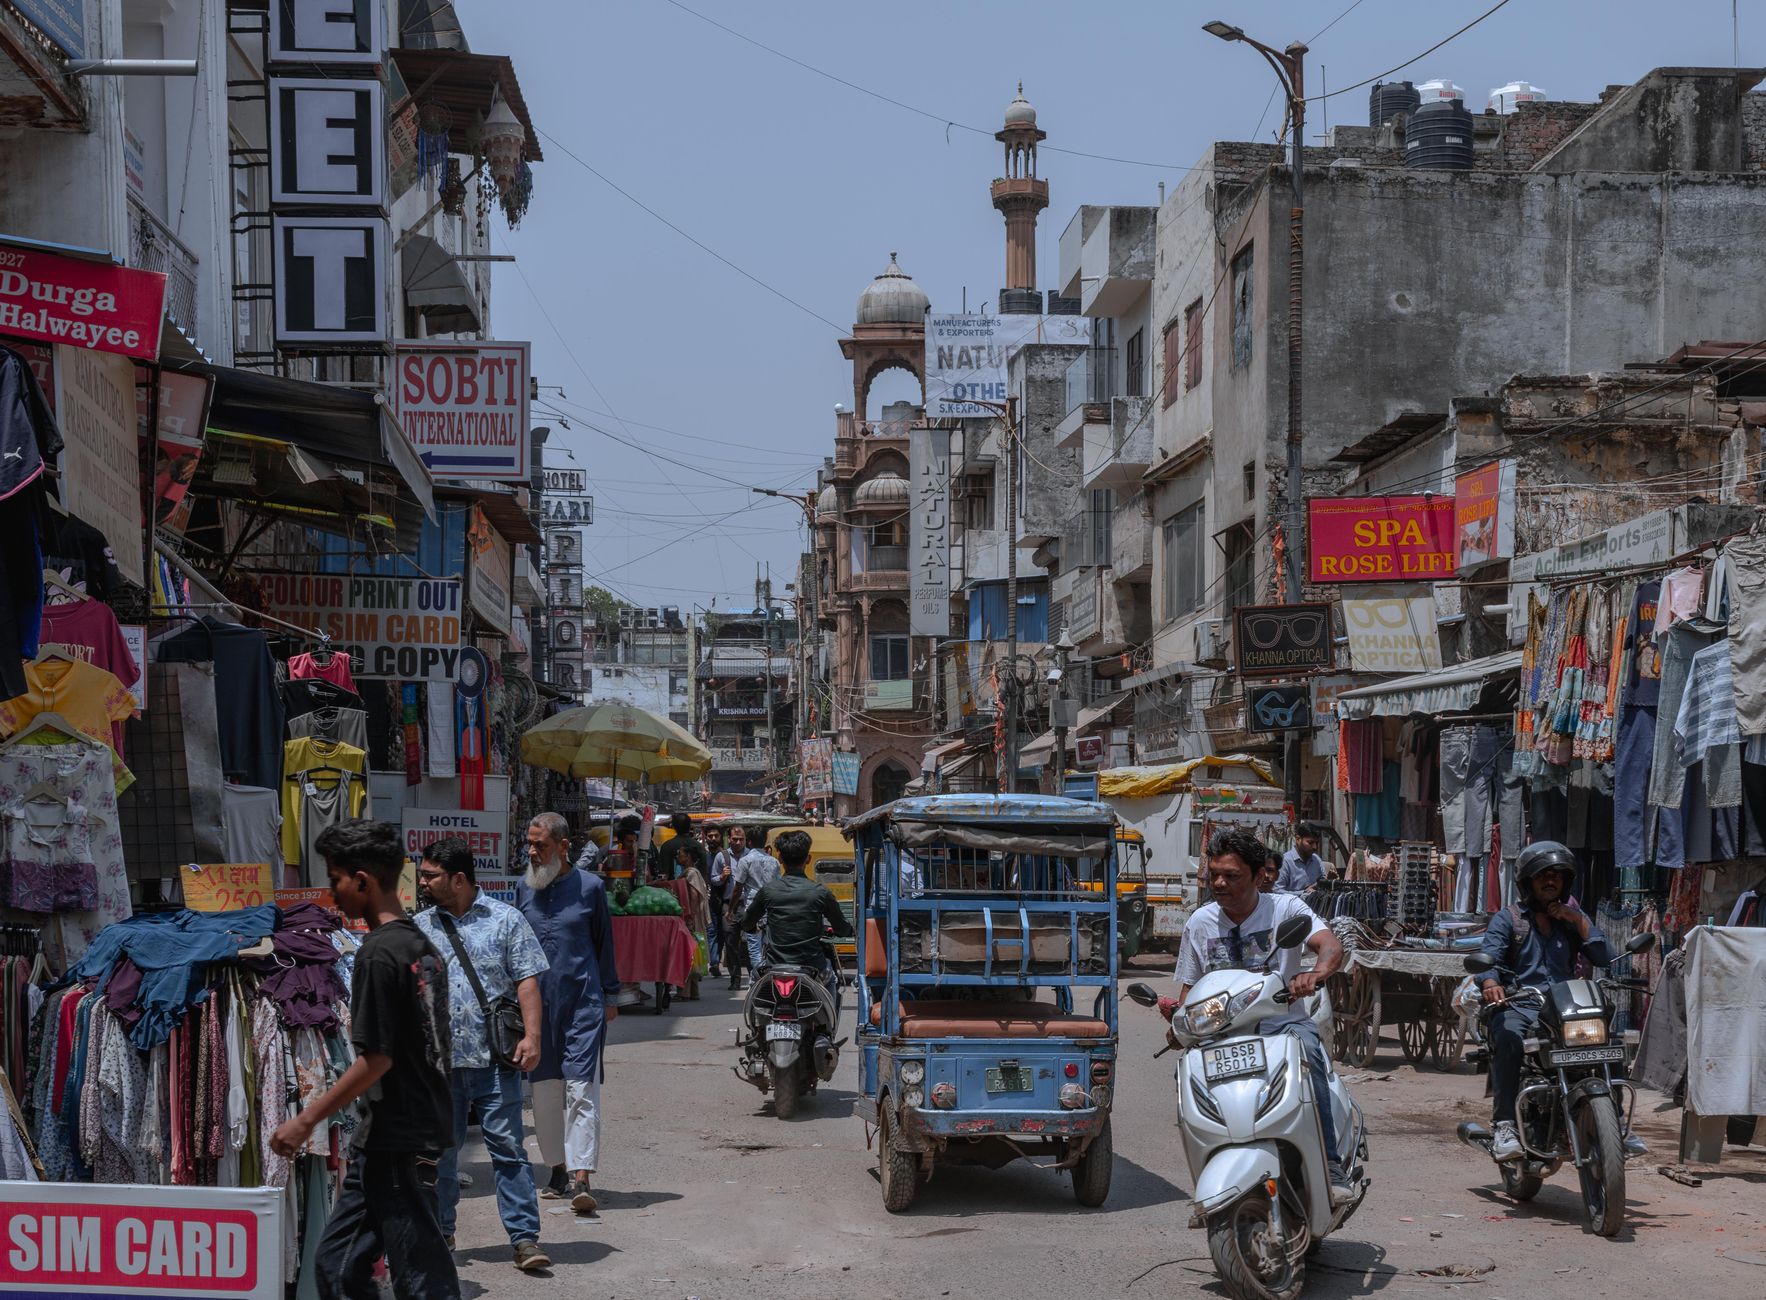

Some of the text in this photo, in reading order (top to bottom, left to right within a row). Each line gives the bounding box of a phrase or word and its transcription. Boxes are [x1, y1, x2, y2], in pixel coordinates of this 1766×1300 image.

[0, 270, 118, 316] Durga
[0, 302, 140, 348] Halwayee
[933, 319, 1002, 327] MANUFACTURERS
[946, 329, 994, 337] EXPORTERS
[403, 355, 517, 406] SOBTI
[403, 411, 517, 446] INTERNATIONAL
[1353, 518, 1427, 547] SPA
[1535, 548, 1576, 577] Achin
[1580, 526, 1642, 565] Exports
[1319, 554, 1394, 576] ROSE
[260, 574, 344, 607] COLOUR
[349, 579, 413, 610] PRINT
[417, 582, 460, 611] OUT
[326, 612, 378, 642] SIM
[386, 614, 460, 645] CARD
[1351, 634, 1436, 650] KHANNA
[374, 645, 460, 678] COPY
[1245, 648, 1327, 665] KHANNA OPTICAL
[1352, 651, 1440, 667] OPTICAL
[429, 816, 478, 827] HOTEL
[275, 891, 322, 900] Since 1927
[1215, 1044, 1255, 1061] DL6SB
[1216, 1056, 1257, 1073] R5012
[8, 1214, 248, 1279] SIM CARD
